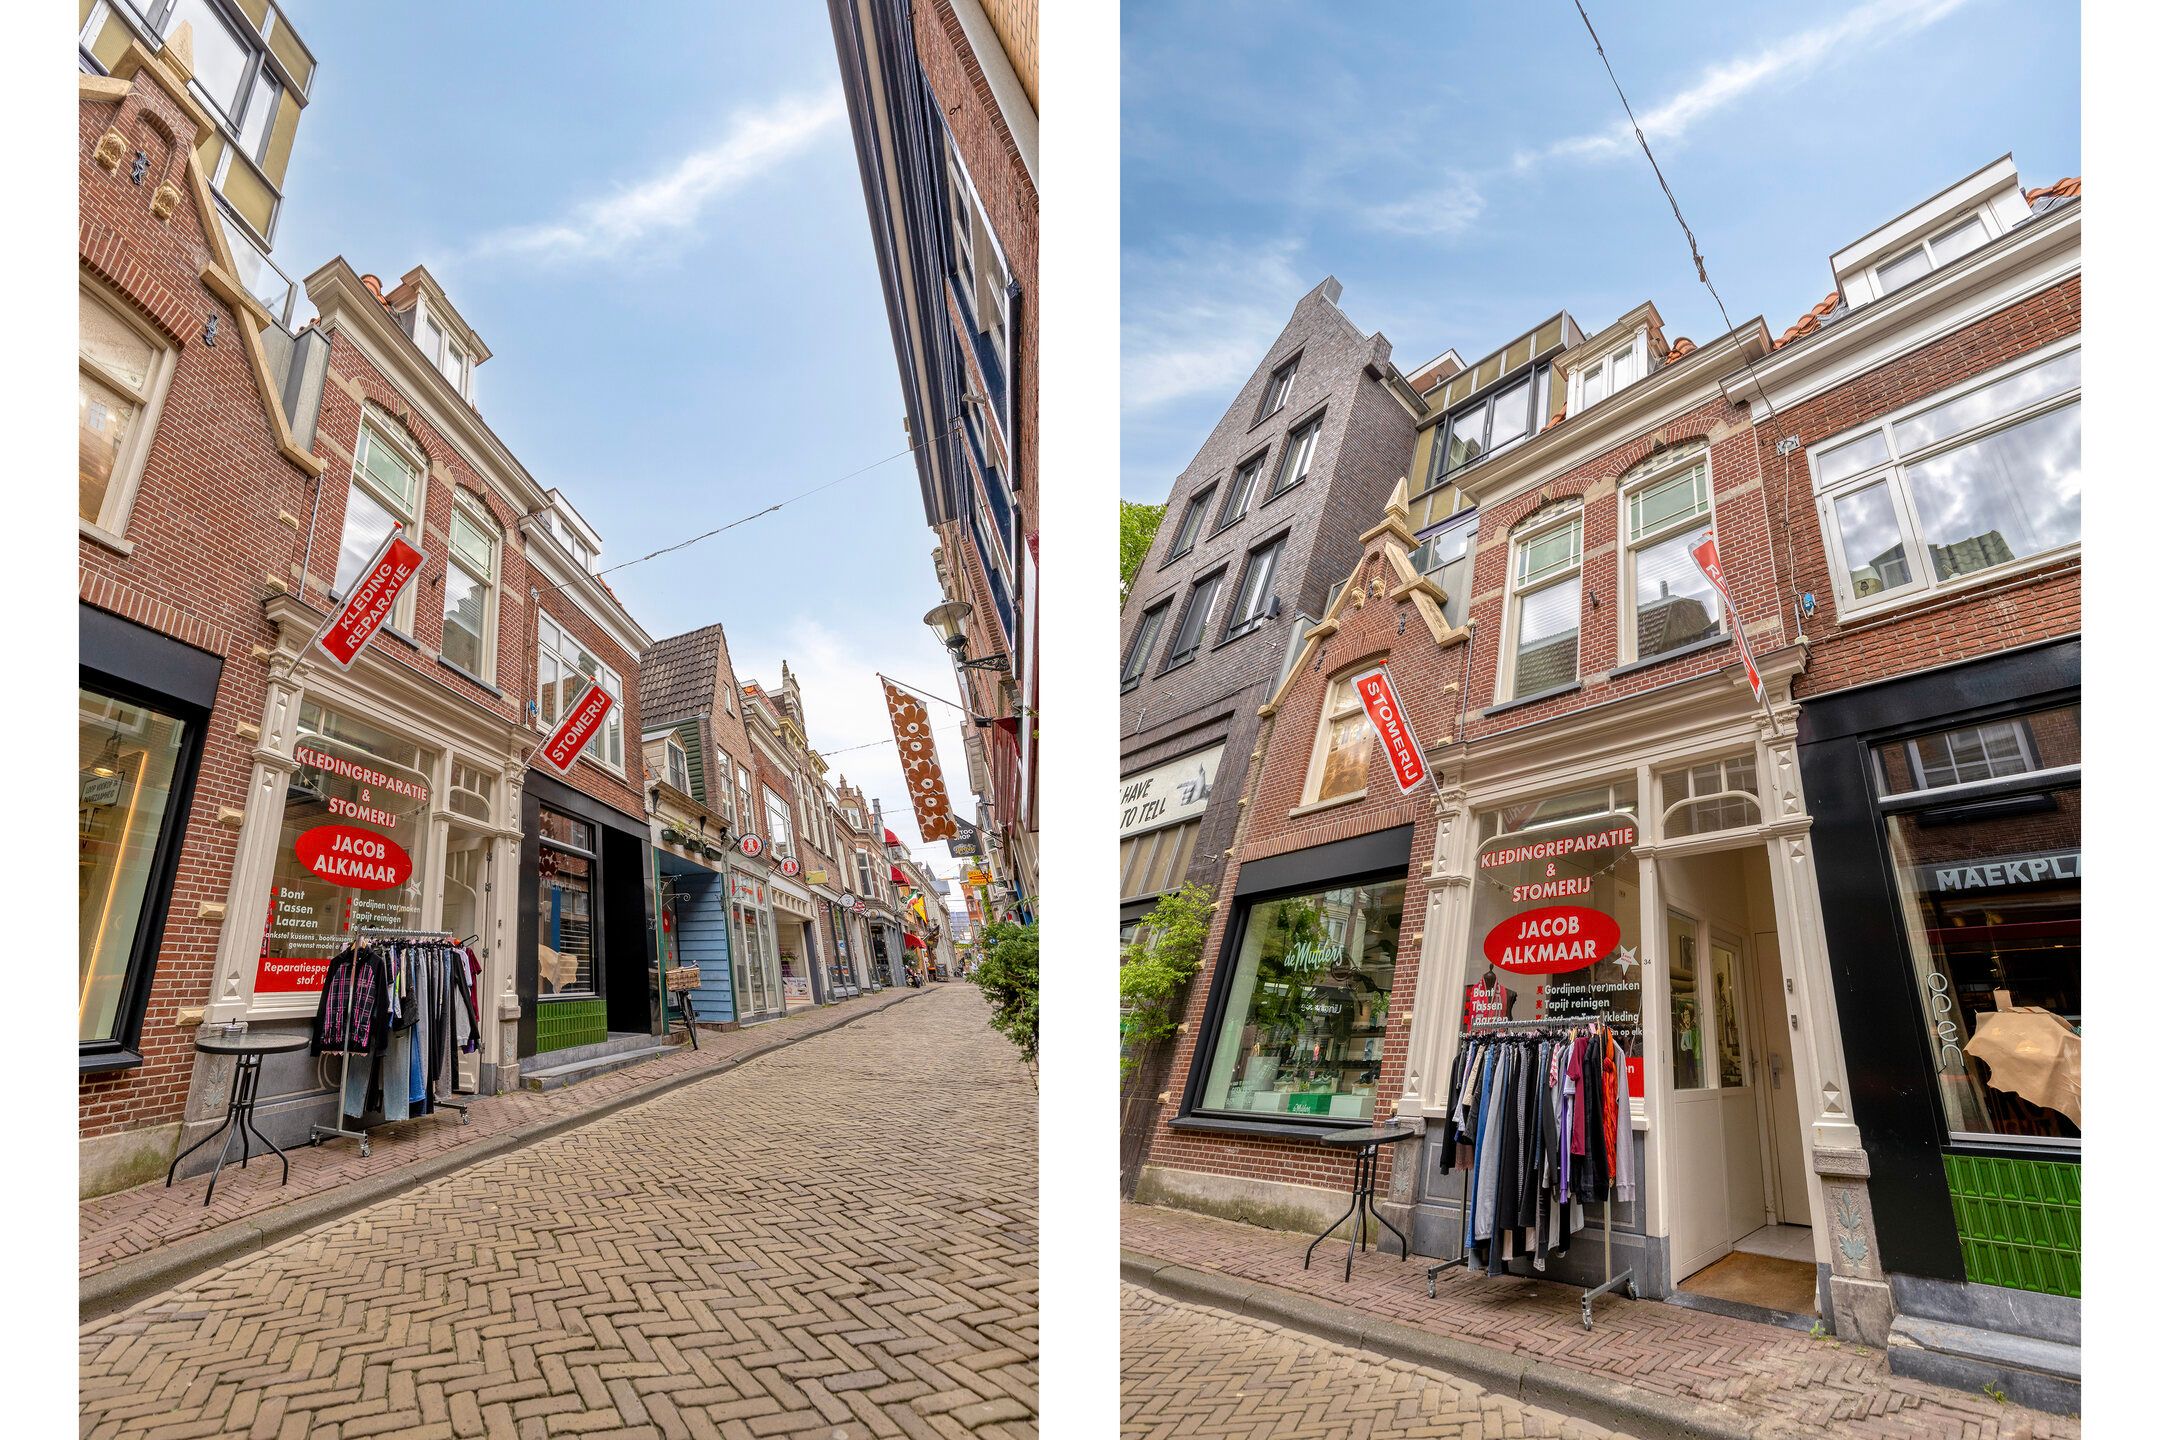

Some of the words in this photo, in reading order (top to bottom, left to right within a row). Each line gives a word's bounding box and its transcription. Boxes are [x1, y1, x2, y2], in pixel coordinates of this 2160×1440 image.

[341, 563, 392, 630] KLEDING
[345, 563, 411, 649] REPARATIE
[552, 693, 605, 761] STOMERIJ
[1367, 681, 1418, 780] STOMERIJ
[296, 747, 428, 801] KLEDINGREPARATIE
[361, 788, 371, 802] &
[1121, 778, 1154, 805] HAVE
[328, 797, 397, 828] STOMERIJ
[1120, 807, 1138, 829] TO
[1138, 798, 1166, 824] TELL
[331, 834, 386, 860] JACOB
[1480, 827, 1633, 868] KLEDINGREPARATIE
[312, 854, 396, 884] ALKMAAR
[1546, 862, 1556, 877] &
[280, 887, 305, 900] Bont
[1512, 876, 1592, 902] STOMERIJ
[279, 901, 313, 914] Tassen
[353, 898, 386, 911] Gordijnen
[276, 915, 318, 928] Laarzen
[352, 910, 373, 922] Tapijt
[373, 914, 402, 924] reinigen
[1518, 915, 1580, 940] JACOB
[315, 942, 335, 950] model
[1500, 939, 1597, 966] ALKMAAR
[1284, 950, 1296, 967] de
[1643, 958, 1652, 966] 34
[296, 975, 315, 985] stof
[1473, 987, 1495, 997] Bont
[1544, 983, 1586, 997] Gordijnen
[1588, 981, 1640, 994] (ver)maken
[1472, 1000, 1503, 1012] Tassen
[1544, 999, 1569, 1012] Tapijt
[1571, 998, 1610, 1010] reinigen
